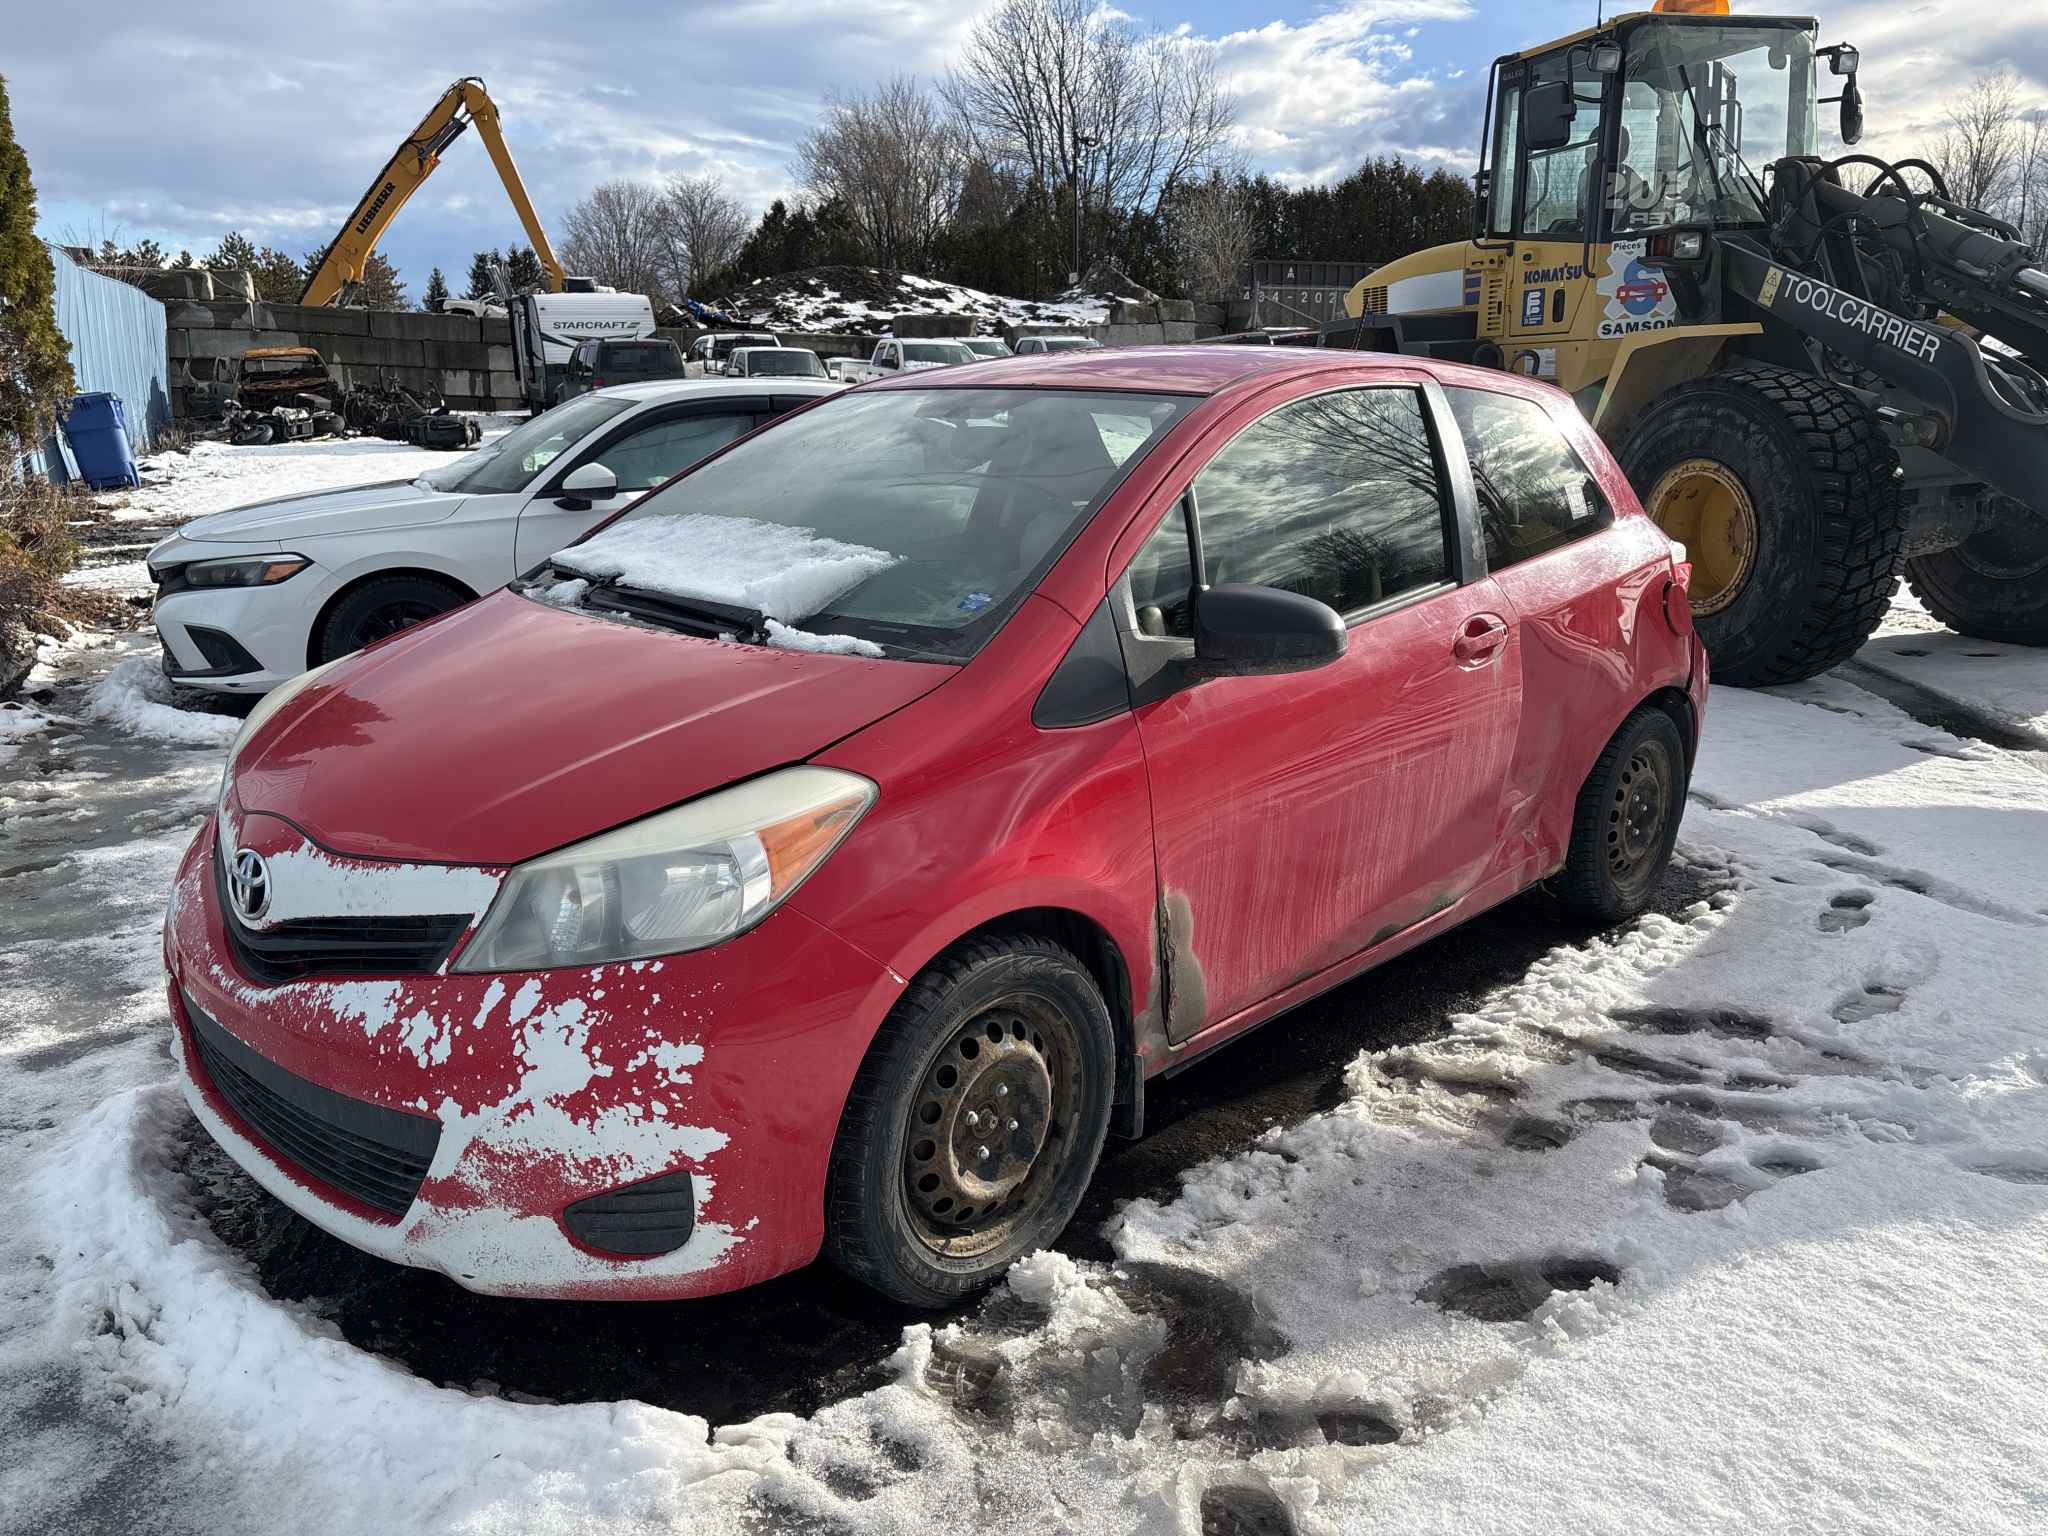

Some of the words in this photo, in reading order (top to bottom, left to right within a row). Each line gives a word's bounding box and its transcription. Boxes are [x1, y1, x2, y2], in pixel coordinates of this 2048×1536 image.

[355, 182, 396, 235] LIEBHERR
[1524, 262, 1584, 284] KOMATSU
[1243, 290, 1338, 304] 434-202
[553, 321, 627, 330] STARCRAFT
[1601, 319, 1675, 336] SAMSON
[1784, 273, 1941, 363] TOOLCARRIER
